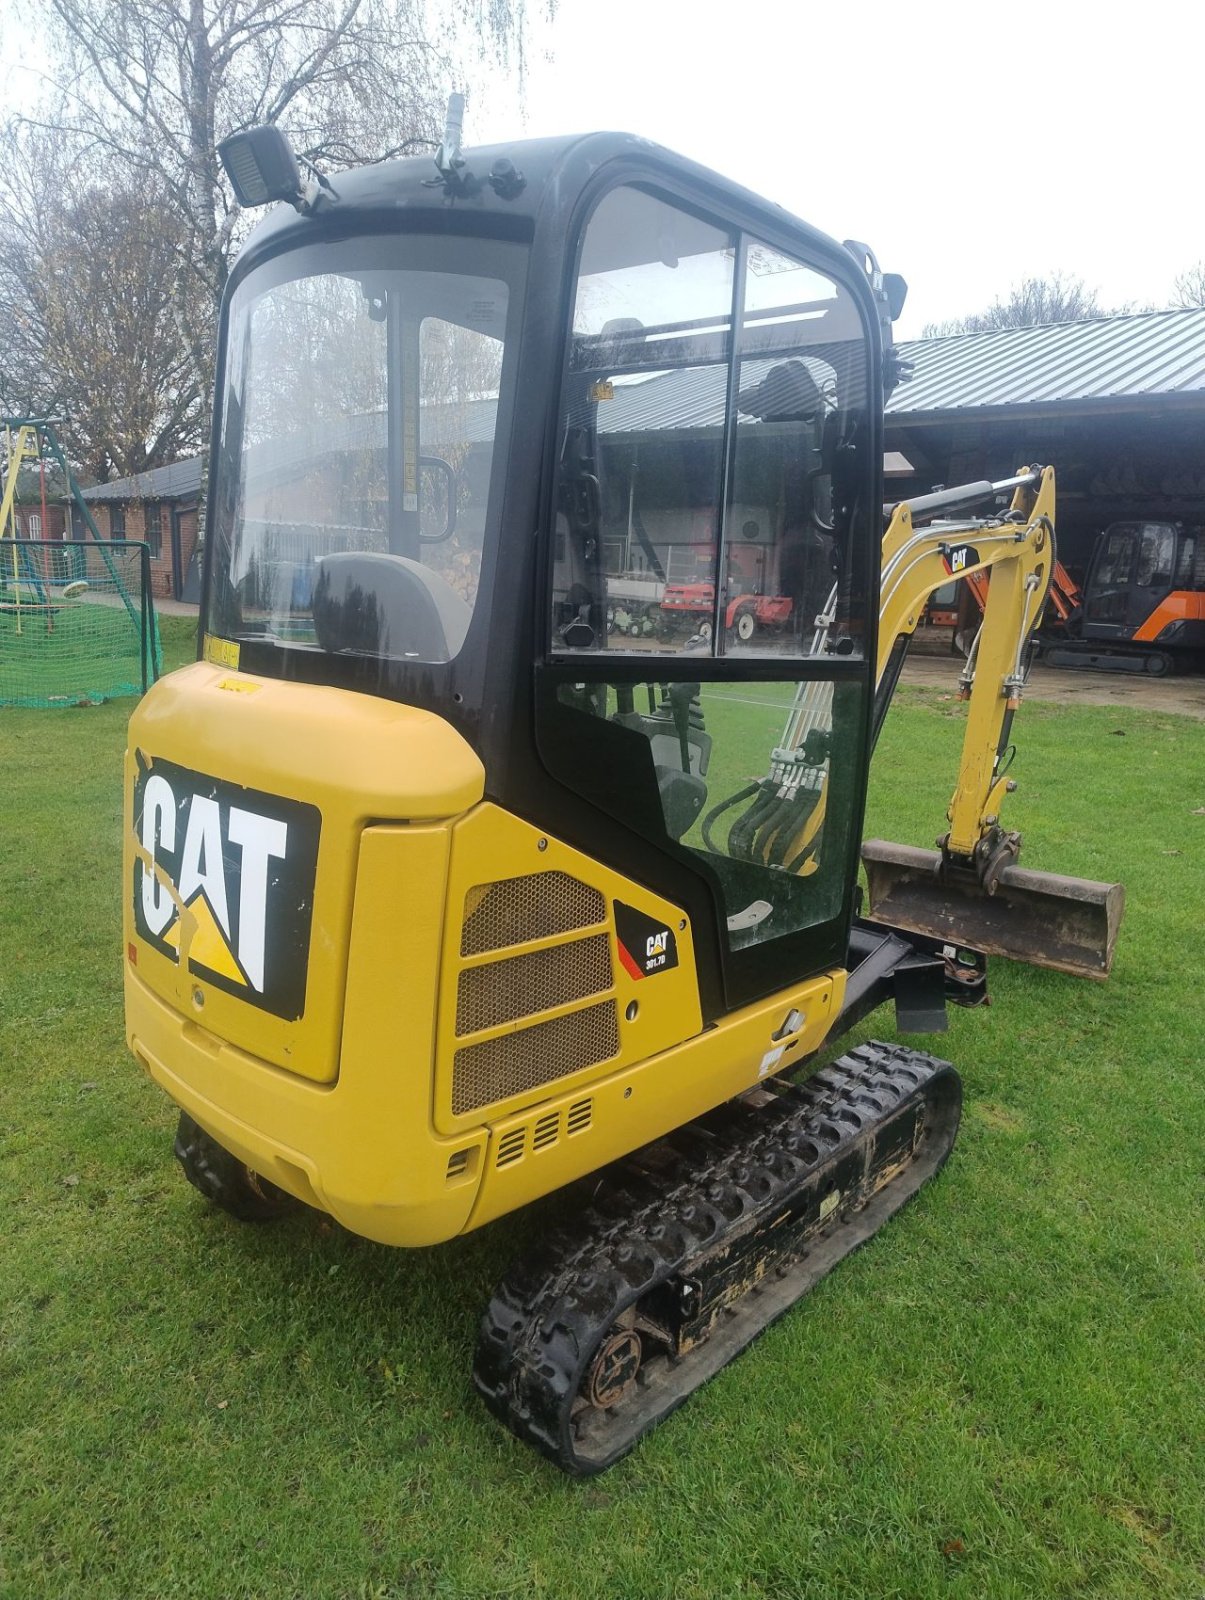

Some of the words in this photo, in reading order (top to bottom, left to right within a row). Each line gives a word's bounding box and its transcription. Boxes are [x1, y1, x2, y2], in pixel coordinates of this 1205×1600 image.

[952, 548, 967, 572] CAT
[142, 775, 288, 993] CAT
[646, 931, 668, 957] CAT
[646, 955, 666, 970] 301.7D
